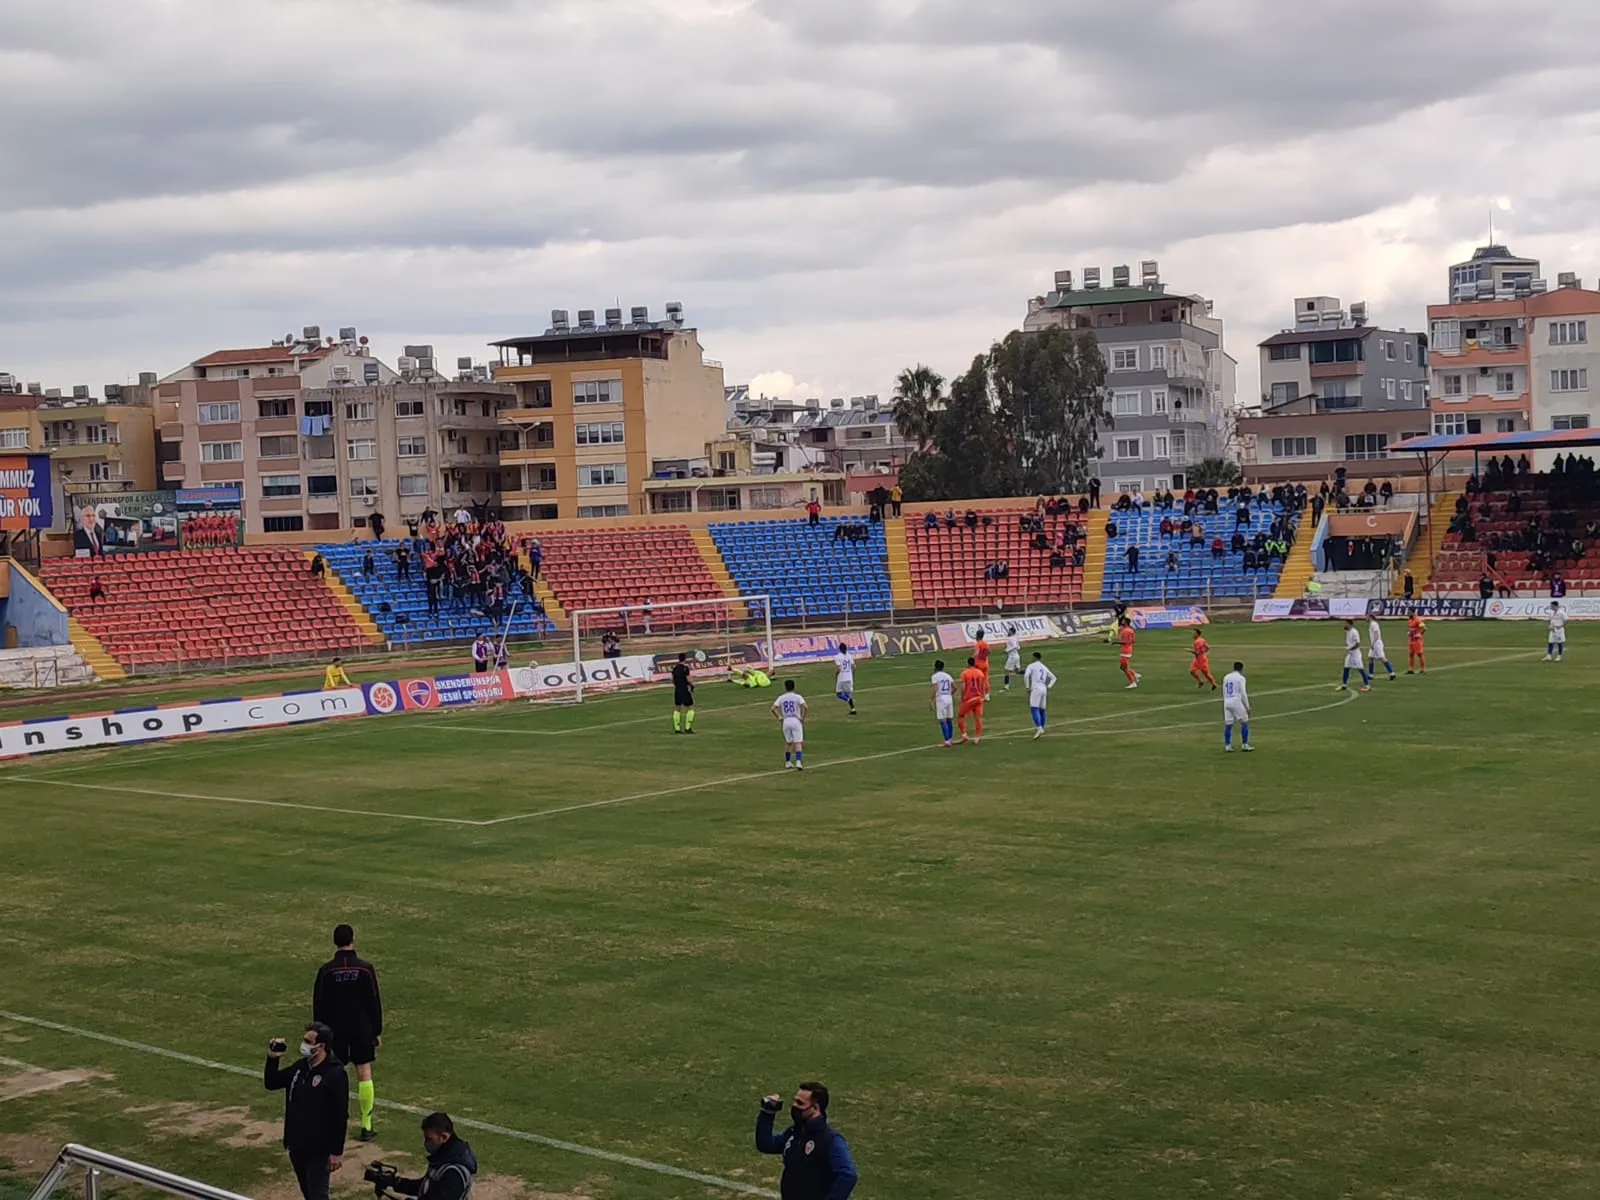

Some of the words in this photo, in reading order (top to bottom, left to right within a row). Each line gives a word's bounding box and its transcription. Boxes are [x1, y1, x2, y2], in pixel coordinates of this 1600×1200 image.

[18, 498, 41, 516] YOK
[1366, 515, 1377, 527] C
[543, 660, 631, 687] odak
[783, 700, 795, 713] 88
[0, 697, 348, 749] nshop.com
